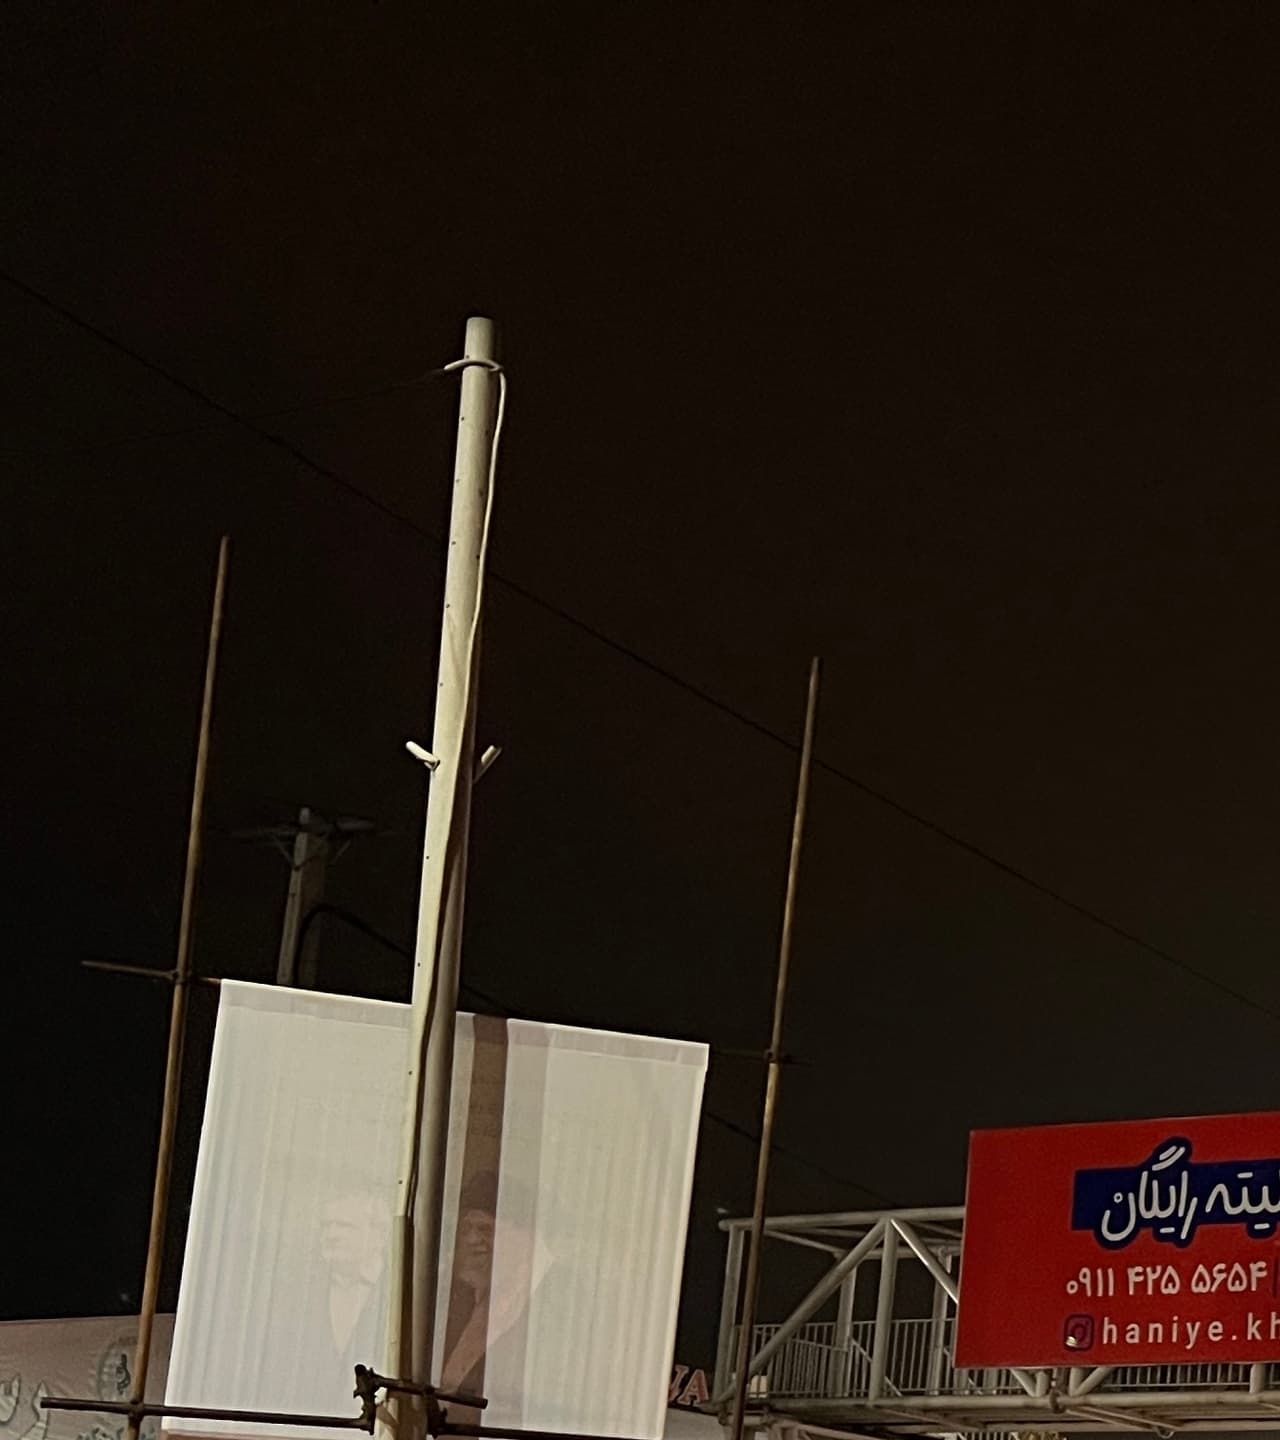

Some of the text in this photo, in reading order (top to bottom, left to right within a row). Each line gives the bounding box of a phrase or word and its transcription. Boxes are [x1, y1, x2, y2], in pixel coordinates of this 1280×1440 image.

[1100, 1144, 1199, 1242] رایگان
[1066, 1260, 1269, 1297] ۰۹۱۱ ۴۲۵ ۵۶۵۴
